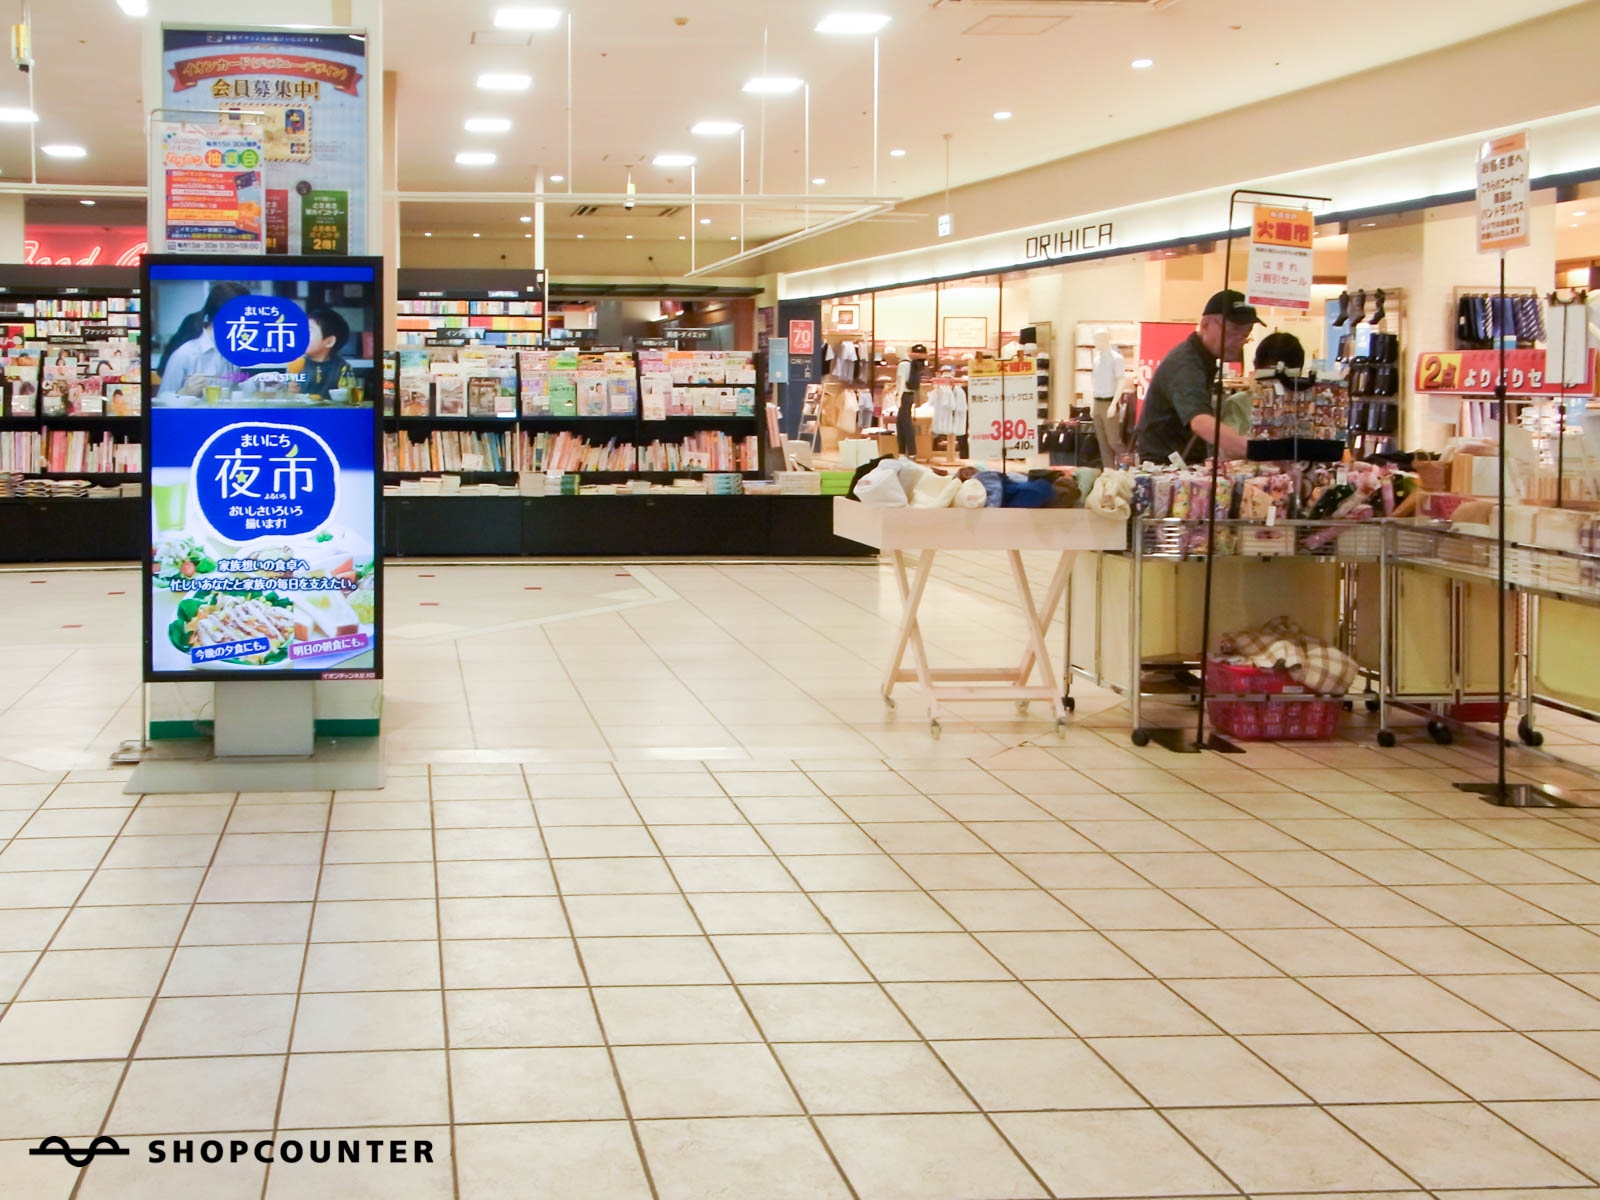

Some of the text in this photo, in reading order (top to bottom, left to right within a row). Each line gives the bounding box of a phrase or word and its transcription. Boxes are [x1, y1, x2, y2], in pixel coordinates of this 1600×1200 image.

[212, 78, 320, 99] 会員募集中!
[1026, 222, 1112, 260] ORIHICA
[1256, 221, 1309, 242] 火曜市
[244, 305, 280, 316] まいにち
[225, 314, 298, 353] 夜市
[792, 328, 811, 343] 70
[1423, 355, 1457, 389] 2点
[241, 434, 291, 447] まいにち
[214, 445, 317, 500] 夜市
[229, 506, 303, 517] おいしさいろいろ
[245, 518, 287, 530] 揃います!
[218, 559, 310, 572] 家族想いの食卓へ
[170, 578, 357, 592] 忙しいあなたと家族の毎日を支えたい。
[194, 641, 267, 661] 今晩の夕食にも。
[292, 638, 366, 657] 明日の朝食にも。
